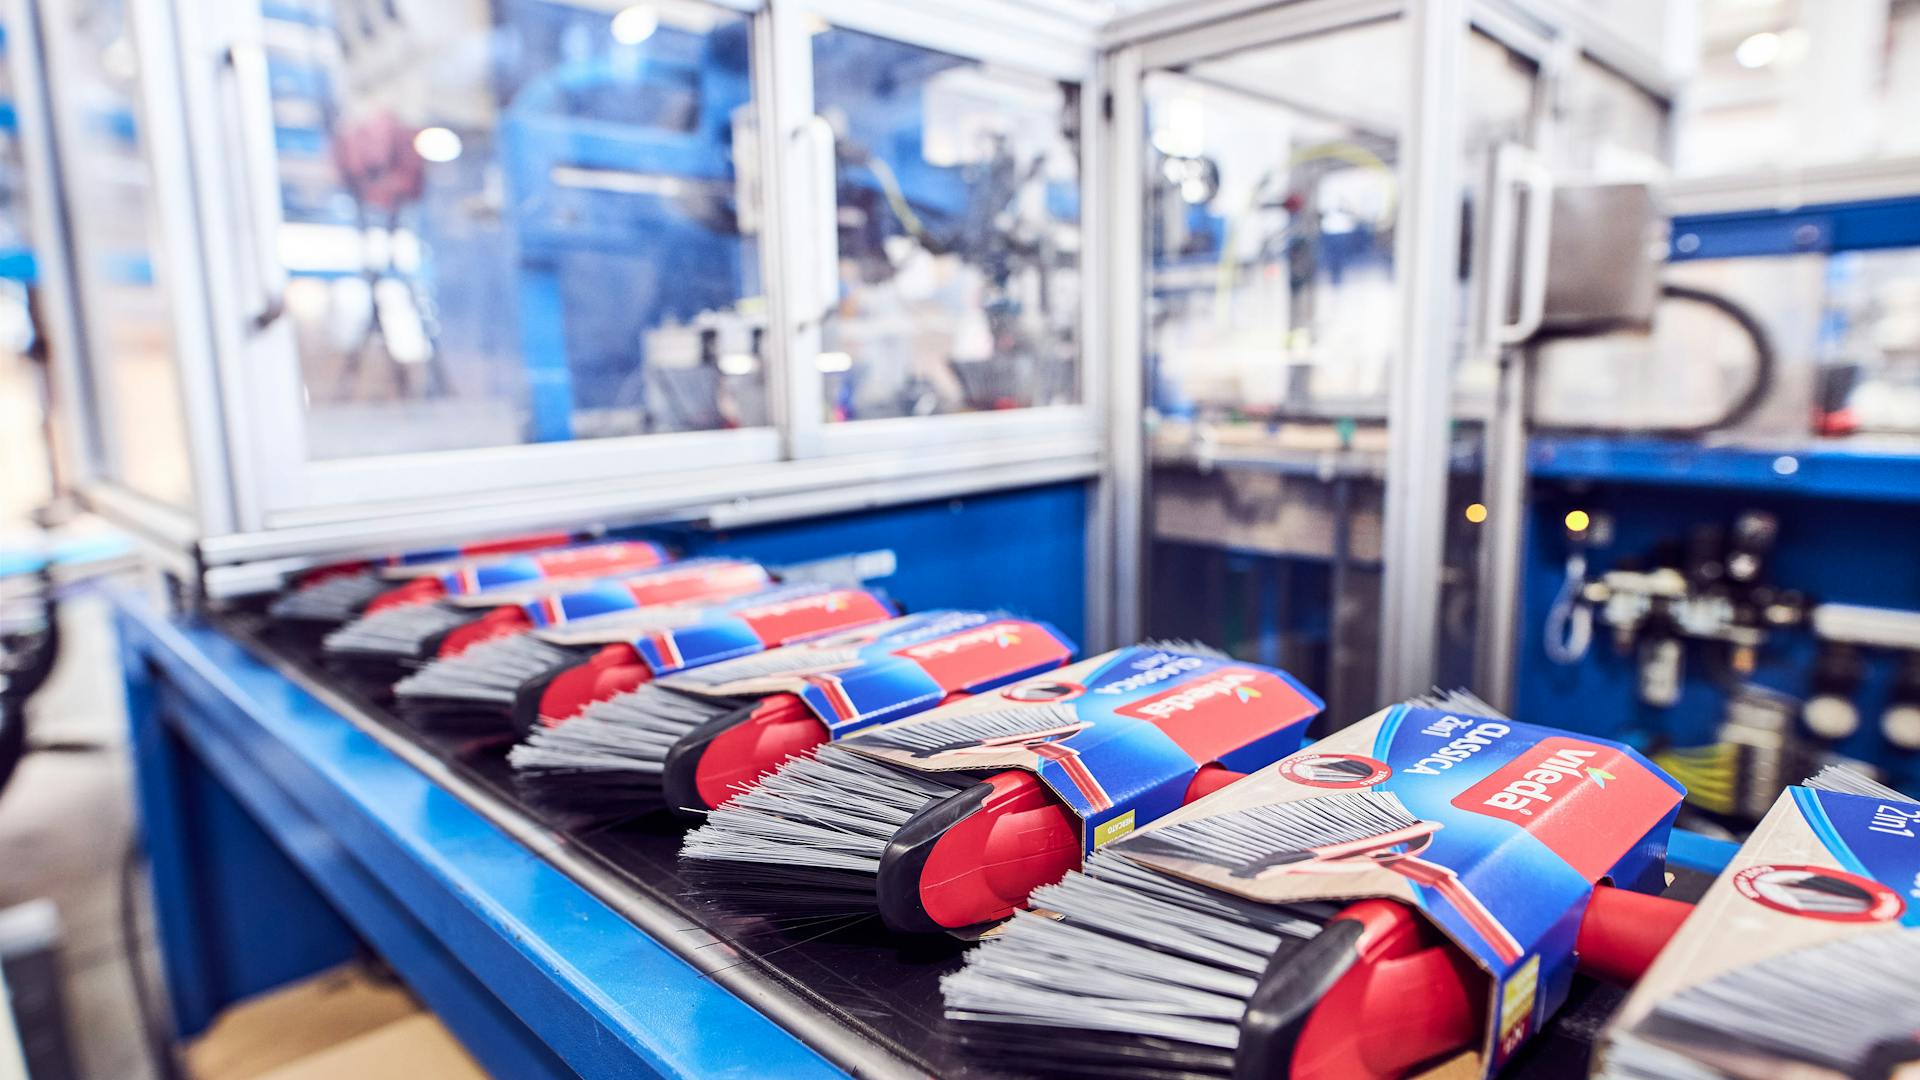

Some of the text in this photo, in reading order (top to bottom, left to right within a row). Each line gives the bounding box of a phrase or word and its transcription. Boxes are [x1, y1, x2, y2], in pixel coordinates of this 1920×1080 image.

[1421, 714, 1474, 738] 2in1
[1402, 722, 1511, 776] CLASSICA
[1868, 804, 1920, 838] 2in1
